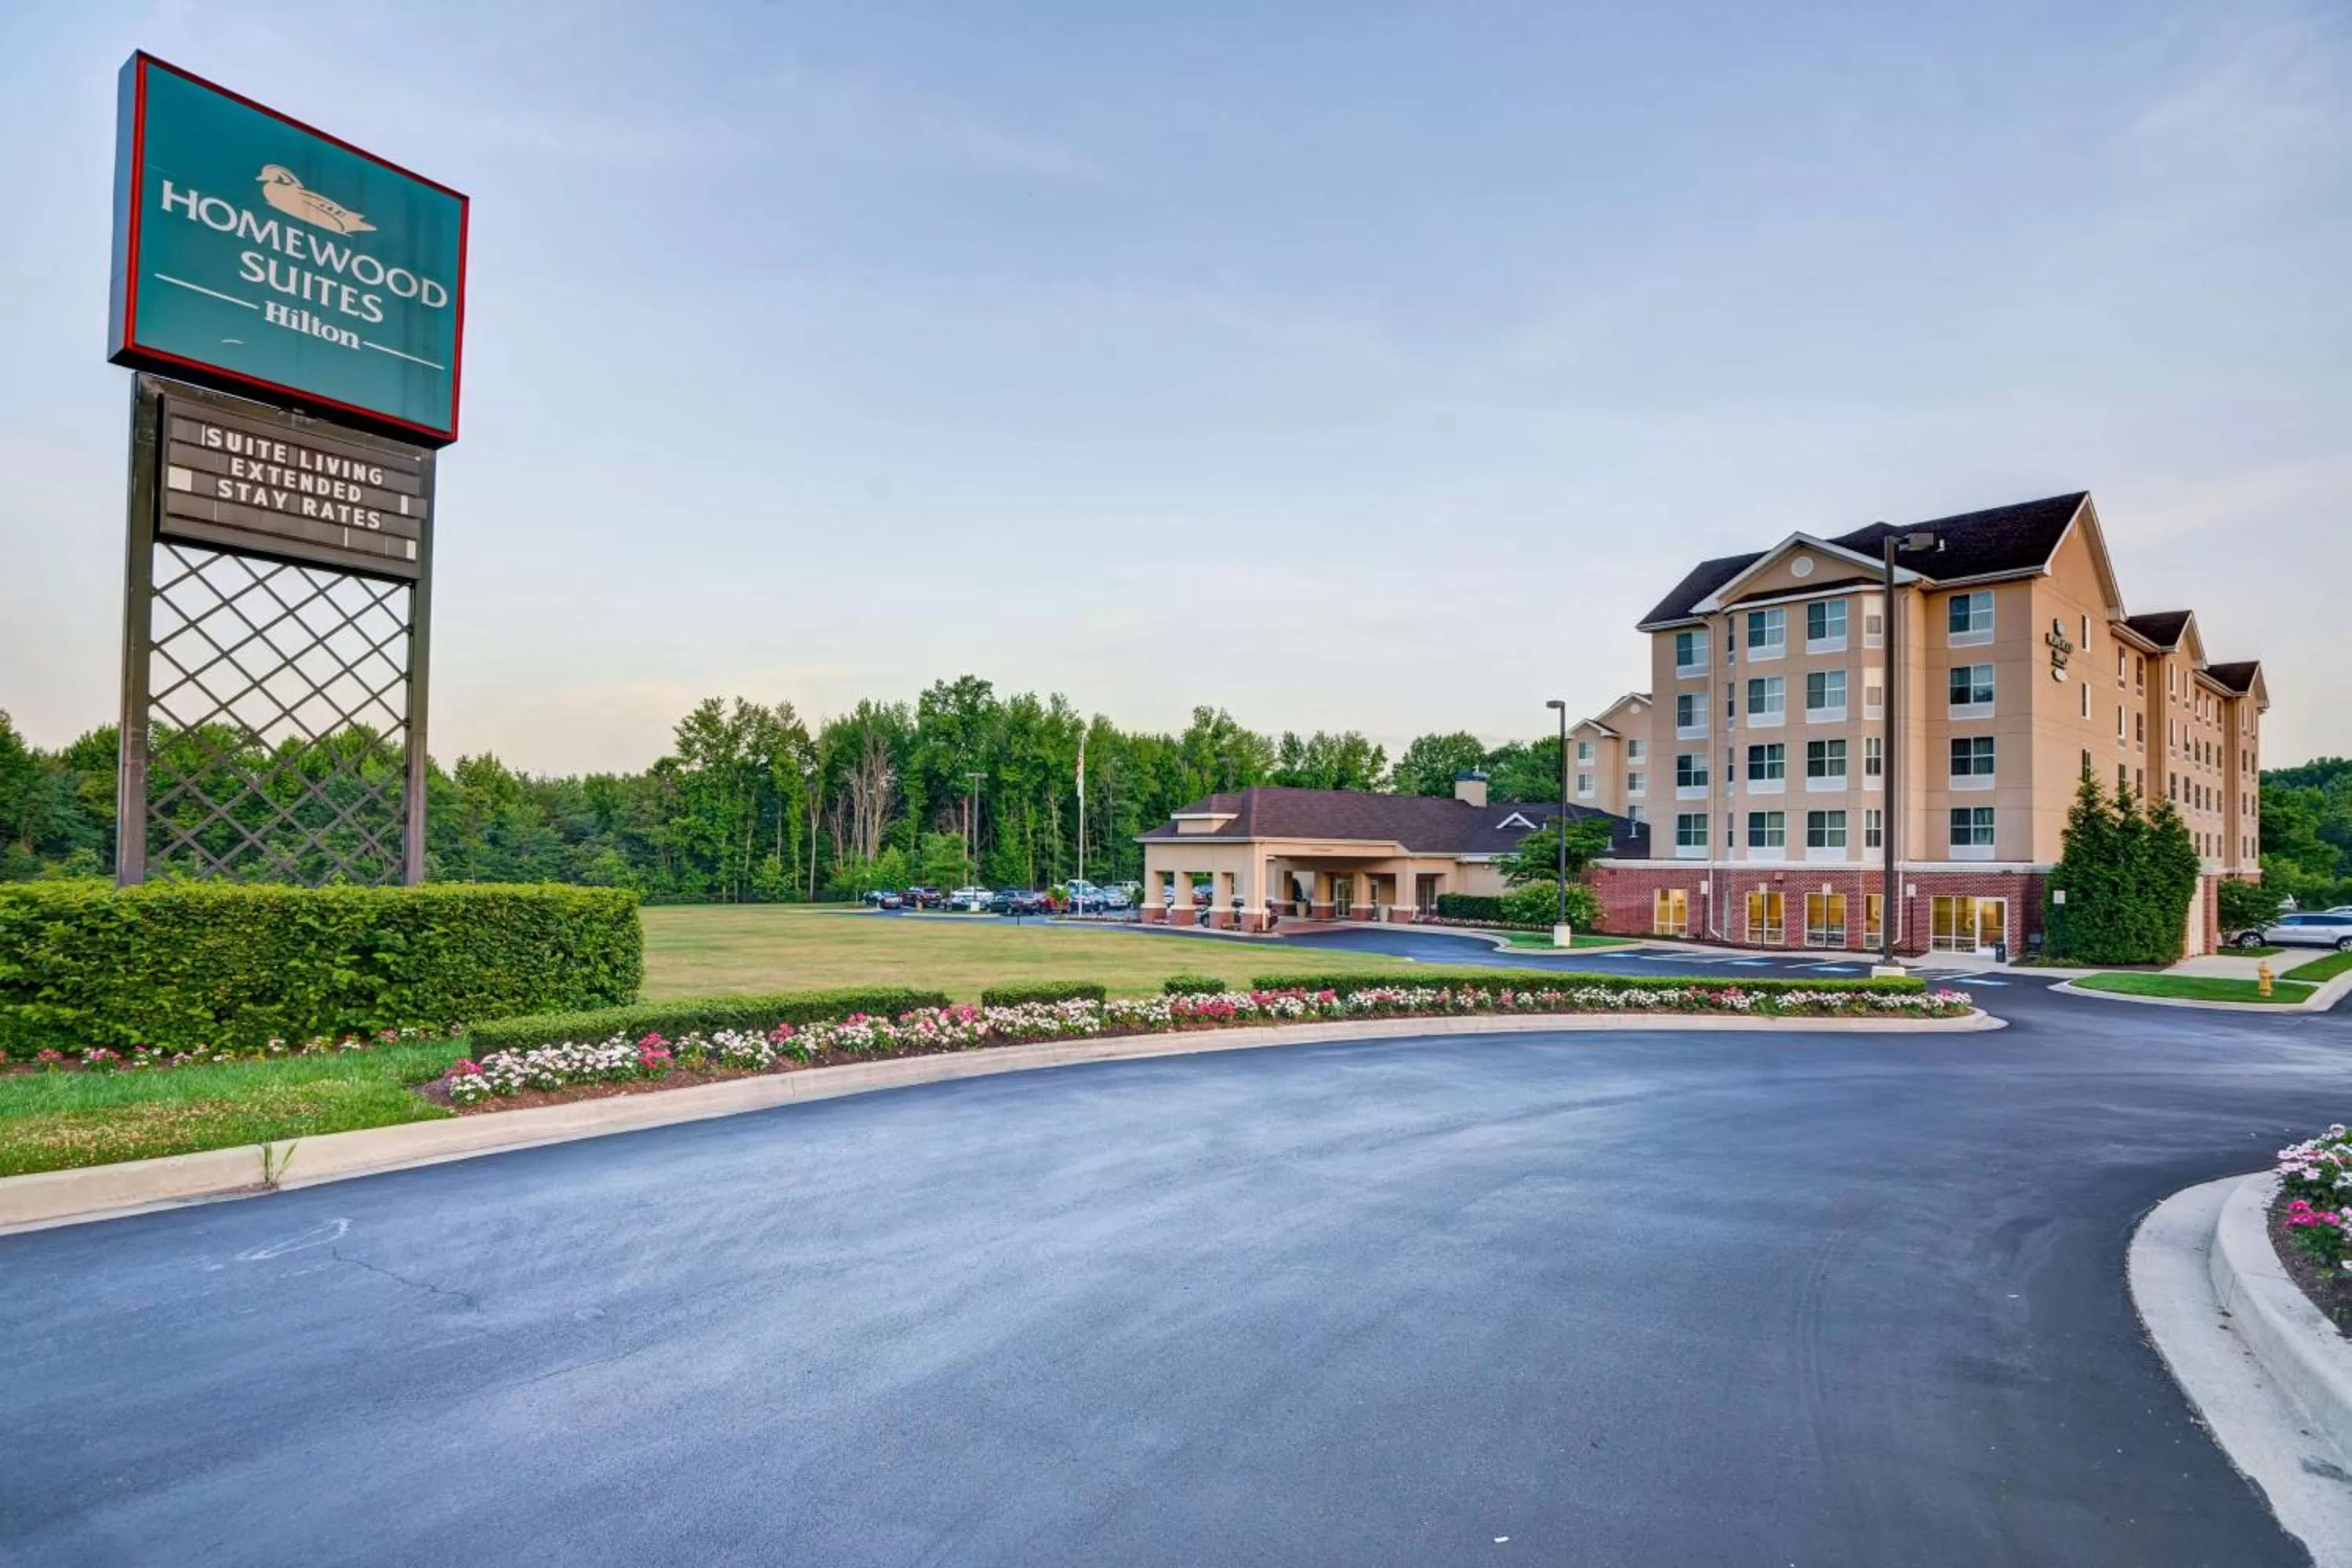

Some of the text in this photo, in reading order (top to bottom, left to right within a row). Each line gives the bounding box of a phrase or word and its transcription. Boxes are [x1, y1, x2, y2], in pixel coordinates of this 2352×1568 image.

[161, 180, 448, 308] HOMEWOOD
[240, 251, 384, 324] SUITES
[263, 299, 361, 350] Hilton
[206, 426, 384, 486] SUITE LIVING
[230, 457, 362, 503] EXTENDED
[216, 478, 381, 529] STAY RATES
